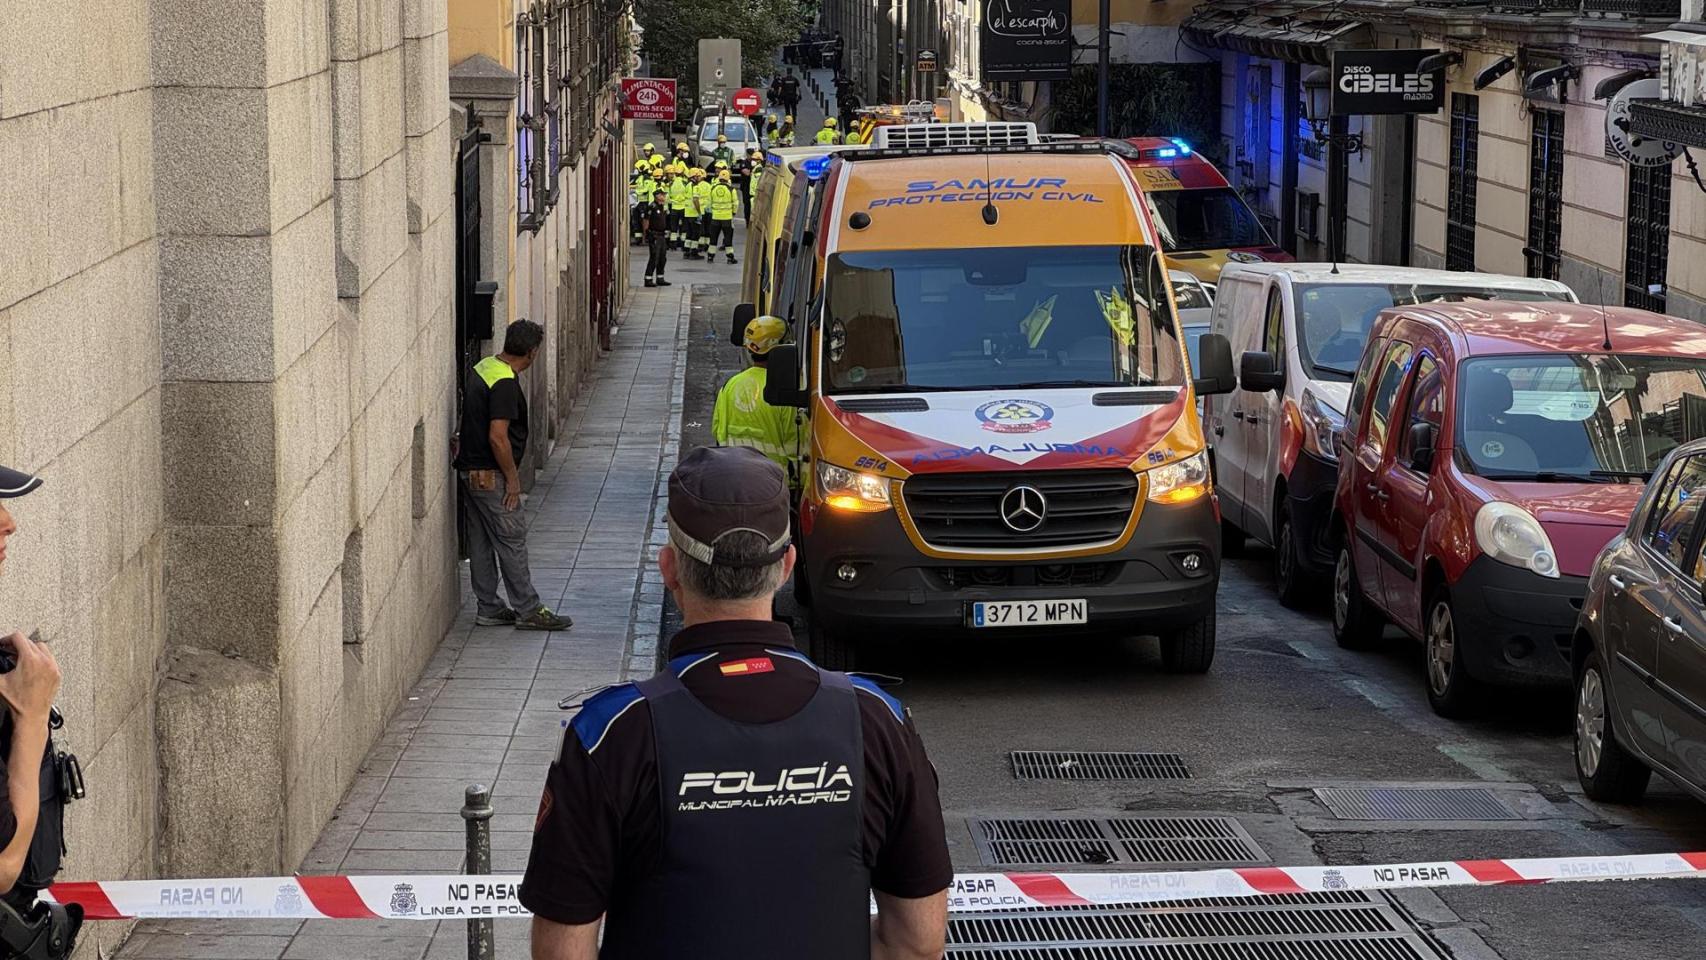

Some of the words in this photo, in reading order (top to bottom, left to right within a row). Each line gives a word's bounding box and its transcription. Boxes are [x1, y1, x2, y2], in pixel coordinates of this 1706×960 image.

[994, 2, 1006, 29] el
[1009, 9, 1059, 36] escarpín
[639, 92, 657, 100] 24h
[1611, 134, 1641, 164] JUAN
[905, 178, 1067, 193] SAMUR
[1041, 191, 1104, 203] CIVIL
[988, 604, 1037, 623] 3712
[1045, 602, 1083, 621] MPN
[678, 761, 853, 796] POLICÍA
[678, 799, 763, 811] MUNICIPAL
[764, 790, 851, 807] MADRID
[1374, 868, 1394, 882] NO
[1399, 867, 1450, 882] PASAR
[448, 884, 469, 900] NO
[421, 906, 465, 915] LINEA
[471, 906, 492, 914] DE
